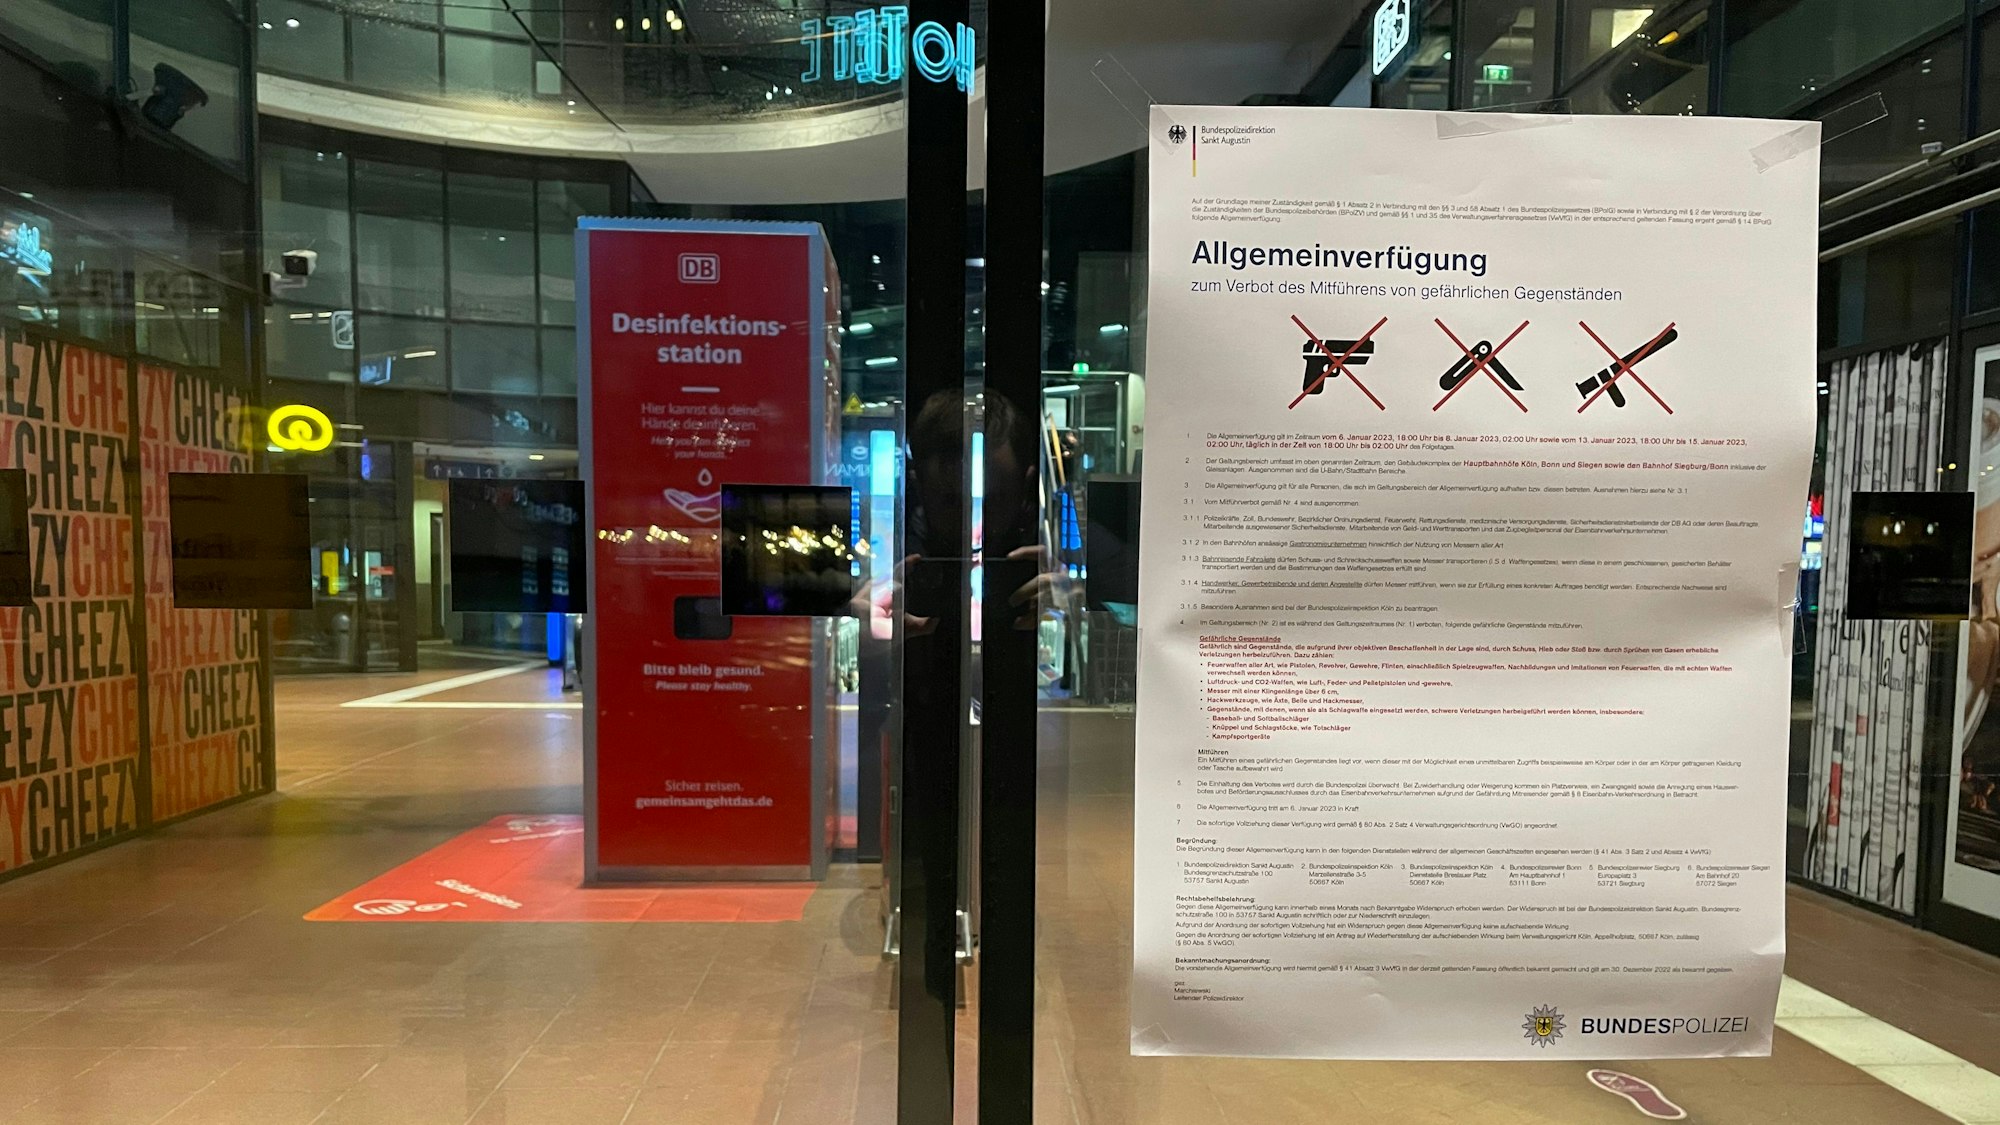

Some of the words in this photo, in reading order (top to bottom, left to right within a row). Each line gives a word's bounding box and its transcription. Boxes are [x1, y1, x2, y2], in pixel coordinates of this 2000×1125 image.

[1201, 124, 1275, 135] Bundespolizeidirektion
[1200, 135, 1219, 144] Sankt
[1220, 135, 1250, 146] Augustin
[1191, 240, 1486, 277] Allgemeinverfügung
[685, 259, 714, 277] DB
[1190, 281, 1221, 292] zum
[1225, 278, 1274, 293] Verbot
[1278, 280, 1305, 294] des
[1309, 280, 1386, 296] Mitführens
[1390, 286, 1416, 296] von
[1420, 283, 1509, 300] gefährlichen
[1513, 285, 1621, 303] Gegenständen
[612, 312, 787, 337] Desinfektions-
[657, 342, 742, 364] station
[0, 330, 64, 423] EZY
[641, 402, 665, 414] Hier
[668, 402, 706, 415] kannst
[709, 403, 724, 415] du
[1206, 431, 1217, 439] Die
[1217, 432, 1275, 441] Allgemeinverfügung
[1276, 433, 1285, 441] gilt
[1293, 432, 1320, 440] Zeitraum
[1346, 433, 1371, 441] Januar
[1372, 433, 1394, 442] 2023,
[1453, 434, 1478, 442] Januar
[1479, 434, 1501, 443] 2023,
[1502, 435, 1524, 443] 02:00
[1525, 435, 1538, 443] Uhr
[1640, 437, 1660, 445] 18:00
[1661, 437, 1674, 445] Uhr
[1726, 438, 1747, 446] 2023,
[1206, 440, 1228, 448] 02:00
[1229, 440, 1244, 448] Uhr,
[1245, 440, 1270, 449] täglich
[1323, 441, 1344, 449] 18:00
[1345, 441, 1358, 449] Uhr
[1371, 442, 1394, 450] 02:00
[1395, 442, 1408, 450] Uhr
[1463, 459, 1519, 468] Hauptbahnhöfe
[1520, 460, 1539, 468] Köln,
[1540, 460, 1560, 468] Bonn
[1561, 460, 1576, 468] und
[1577, 460, 1602, 469] Siegen
[1642, 461, 1672, 469] Bahnhof
[1673, 462, 1728, 471] Siegburg/Bonn
[1198, 634, 1237, 643] Gefährliche
[1236, 635, 1281, 643] Gegenstände
[643, 663, 676, 677] Bitte
[679, 663, 712, 677] bleib
[715, 664, 765, 680] gesund.
[655, 681, 688, 691] Please
[690, 681, 712, 692] stay
[1362, 679, 1406, 687] Pelletpistolen
[1261, 688, 1303, 696] Klingenlänge
[1206, 696, 1260, 704] Hackwerkzeuge,
[1256, 715, 1309, 723] Softballschläger
[1211, 723, 1239, 731] Knüppel
[1254, 724, 1299, 732] Schlagstöcke,
[1312, 724, 1351, 732] Totschläger
[1211, 732, 1270, 740] Kampfsportgeräte
[665, 779, 701, 792] Sicher
[704, 780, 744, 792] reisen.
[635, 795, 774, 810] gemeinsamgehtdas.de
[1175, 836, 1216, 845] Begründung:
[1175, 894, 1255, 903] Rechtsbehelfsbelehrung:
[1174, 956, 1270, 965] Bekanntmachungsanordnung:
[1581, 1016, 1748, 1034] BUNDESPOLIZEI
